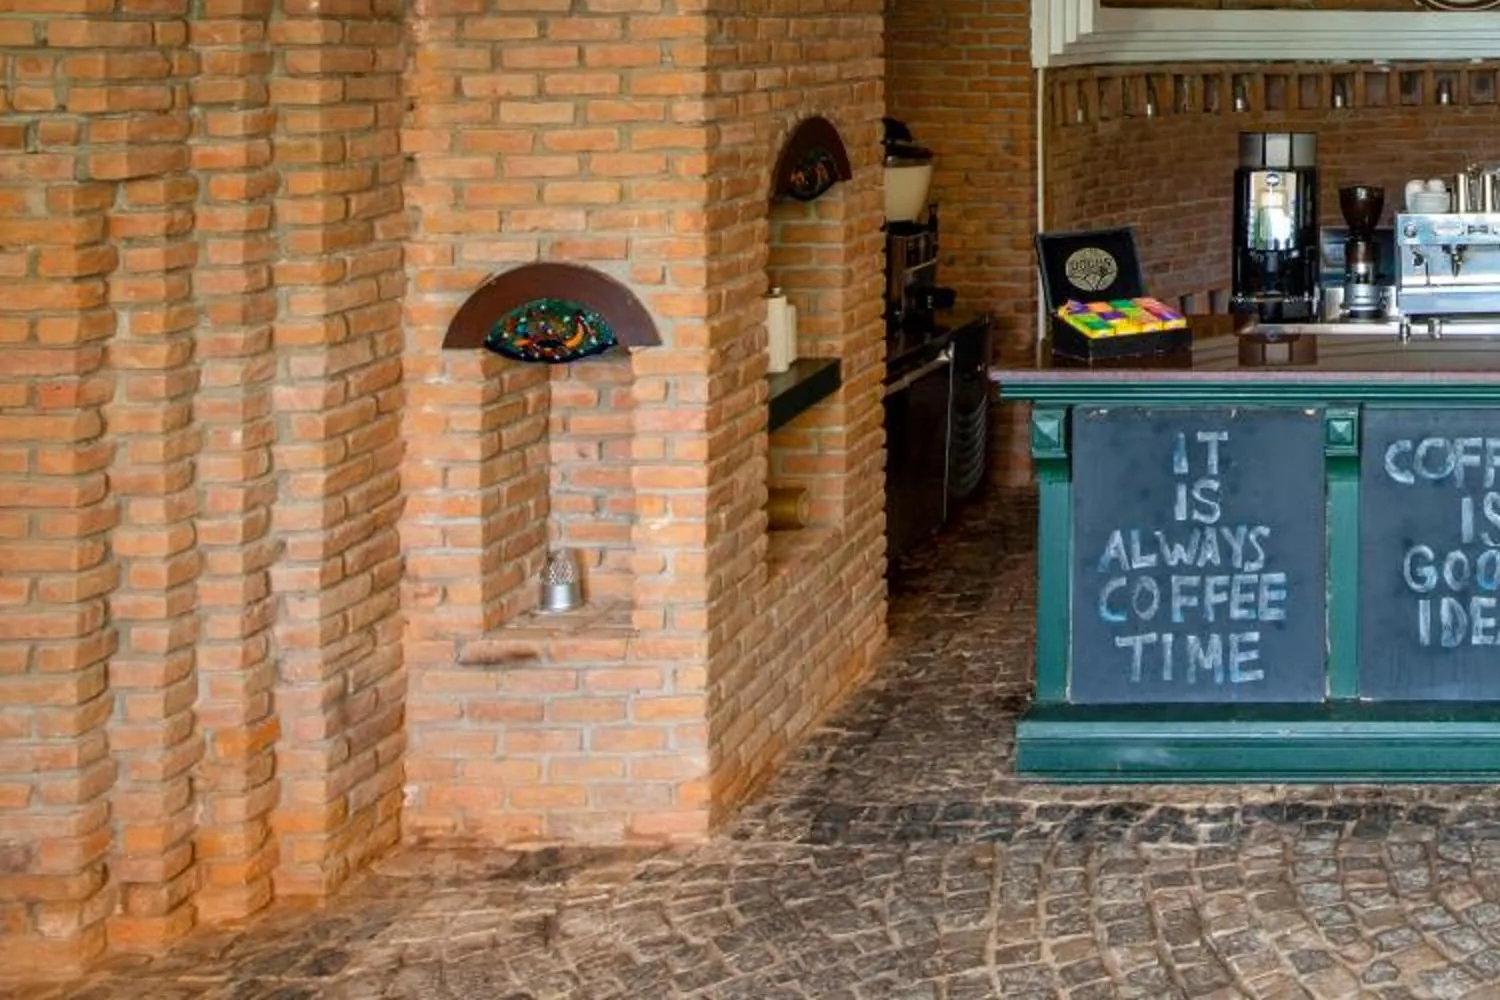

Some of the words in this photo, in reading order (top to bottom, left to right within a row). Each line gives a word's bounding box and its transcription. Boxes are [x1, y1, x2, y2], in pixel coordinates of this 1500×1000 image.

[1173, 431, 1229, 475] IT
[1174, 478, 1222, 524] IS
[1097, 524, 1272, 573] ALWAYS
[1098, 572, 1288, 623] COFFEE
[1114, 631, 1265, 685] TIME
